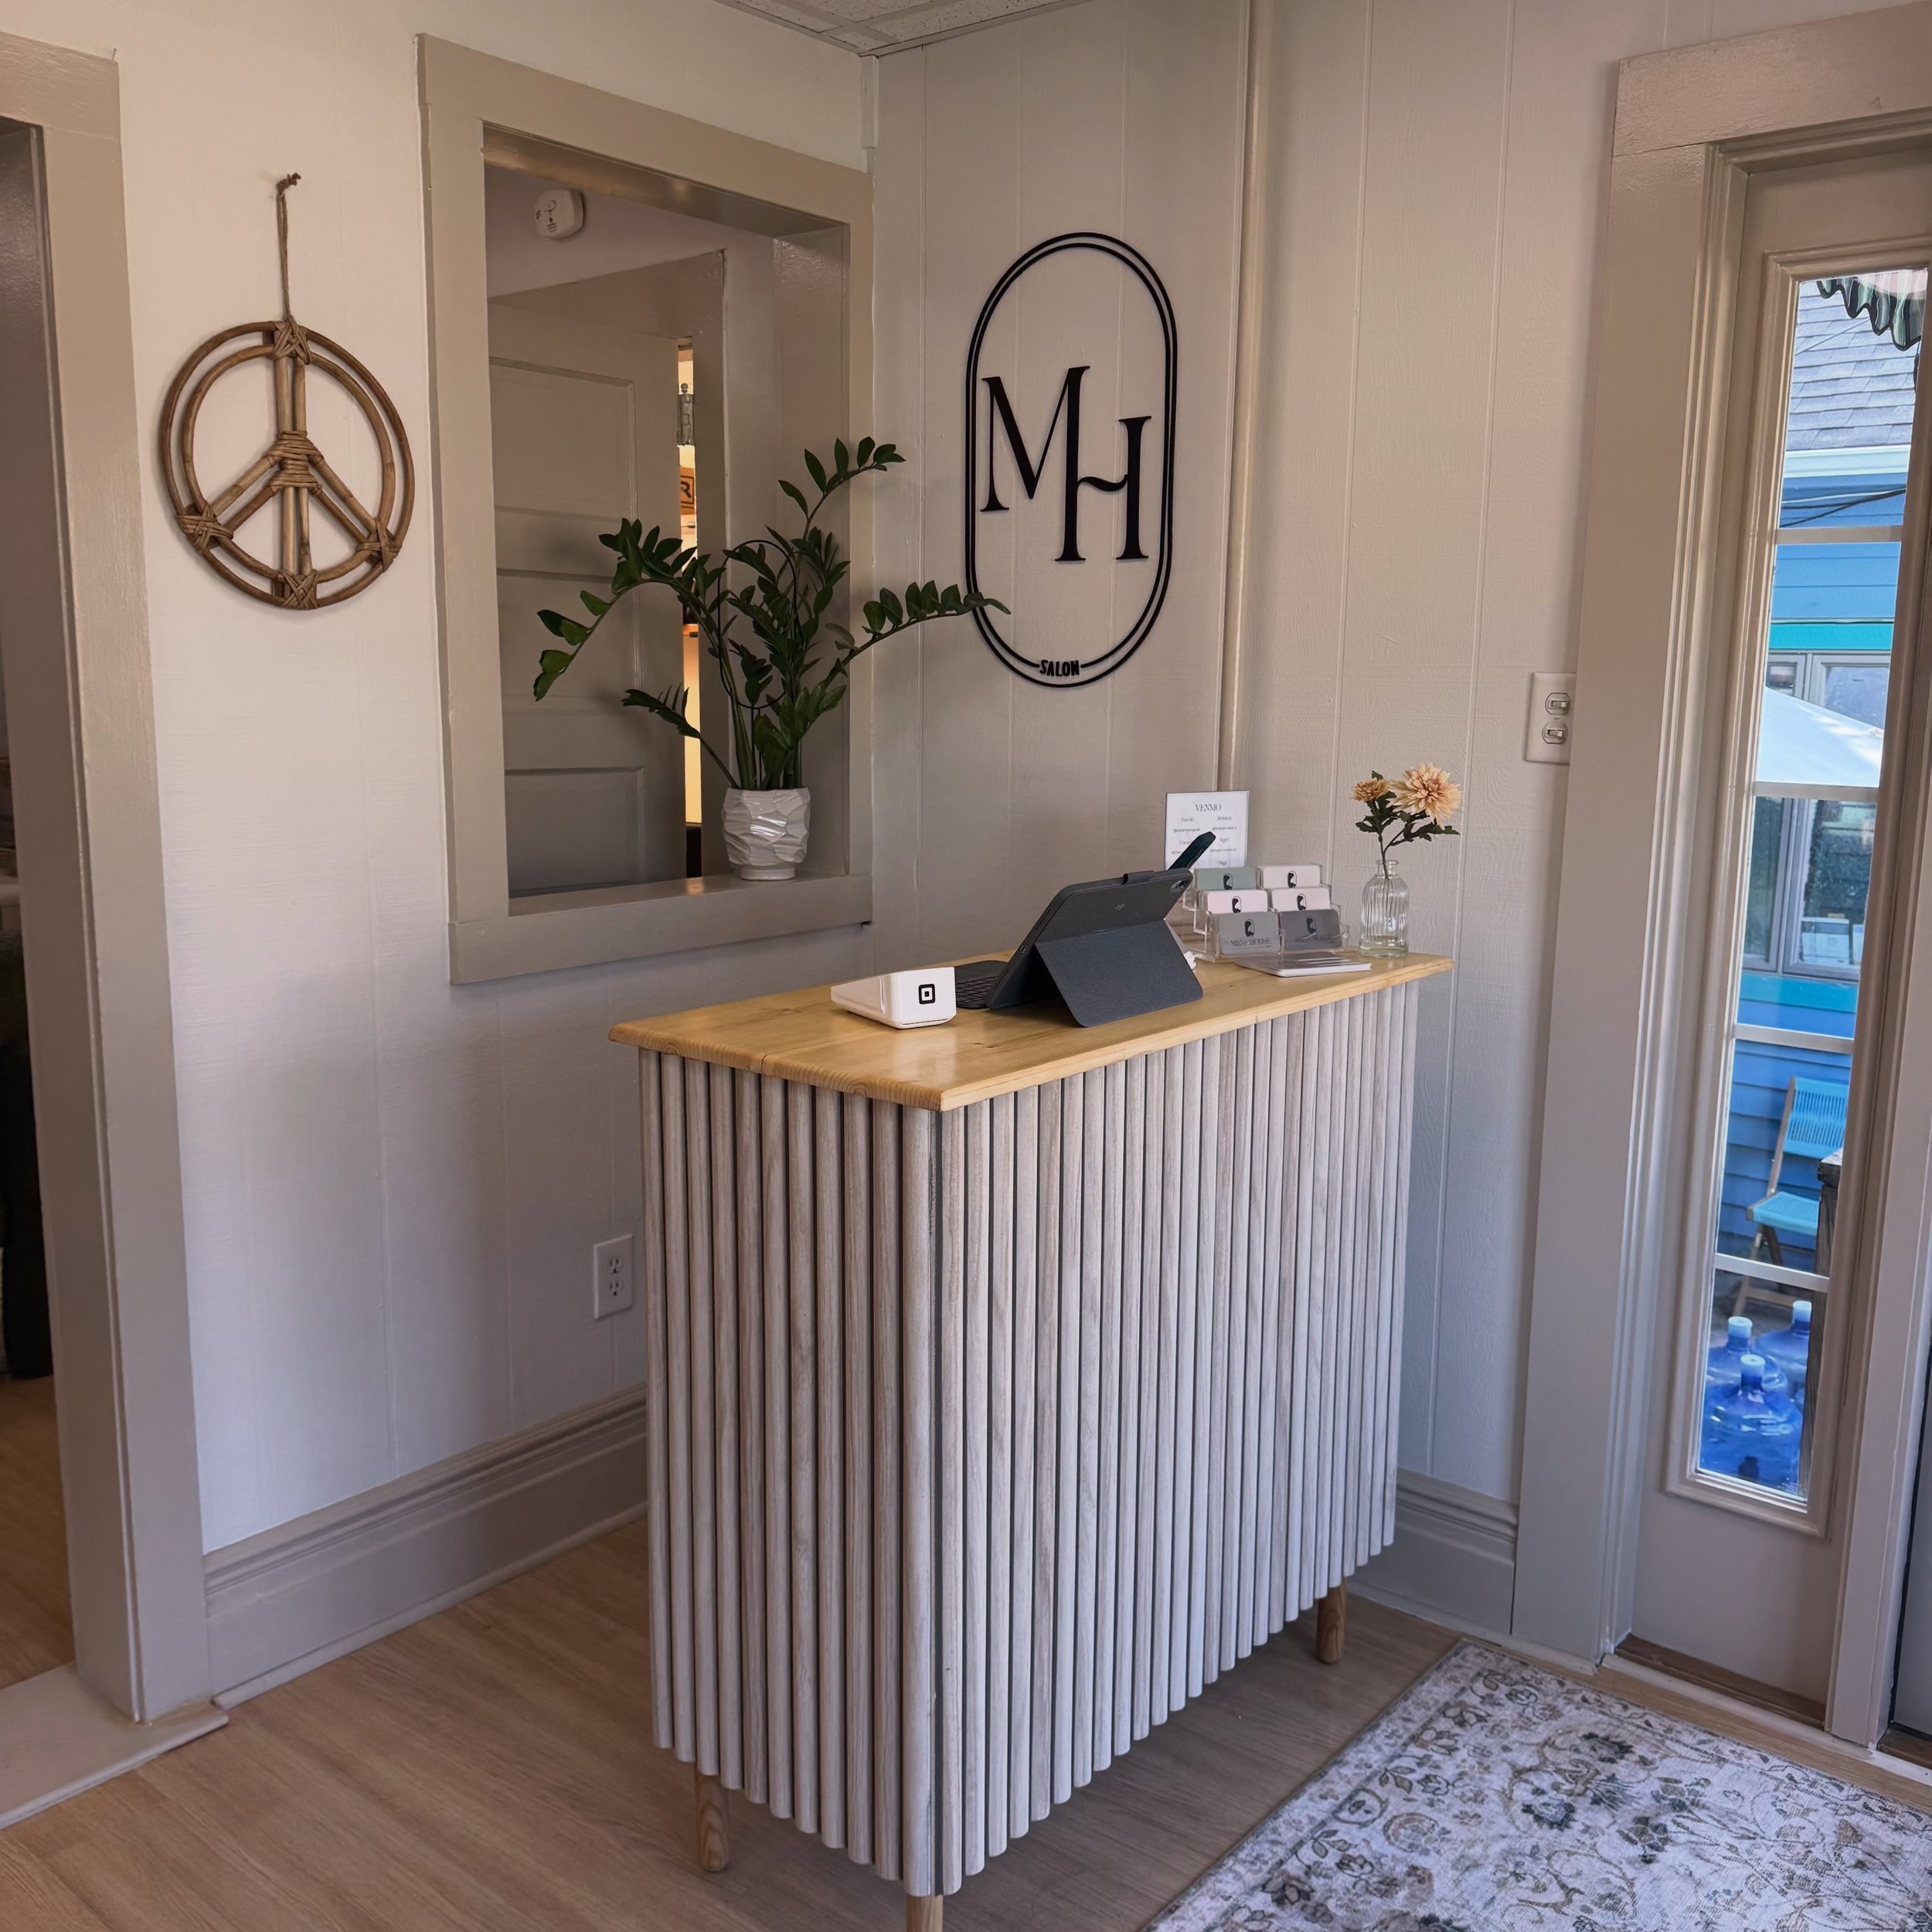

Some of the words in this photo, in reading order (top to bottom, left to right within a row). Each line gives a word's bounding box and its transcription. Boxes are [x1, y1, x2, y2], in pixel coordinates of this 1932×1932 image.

[1039, 659, 1080, 677] SALON
[1196, 803, 1222, 811] VENMO
[1250, 937, 1272, 946] HOUSE
